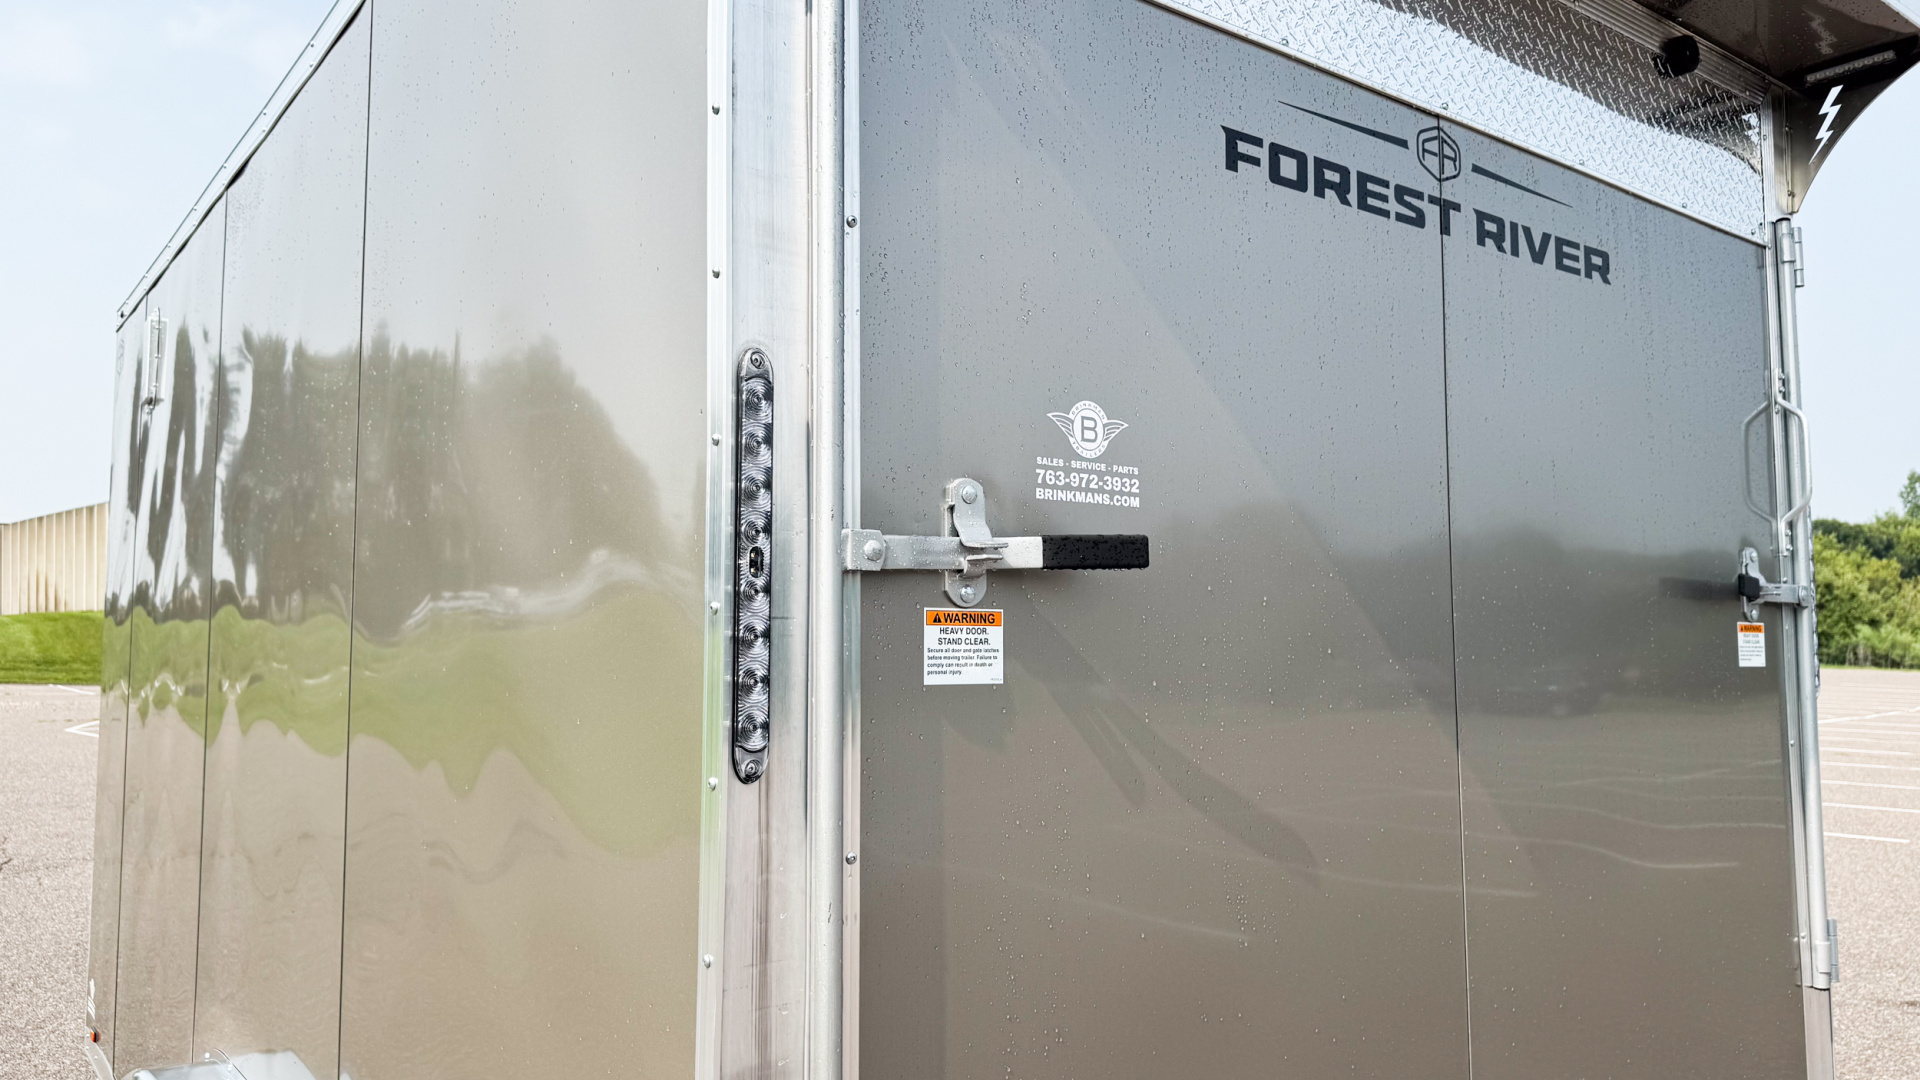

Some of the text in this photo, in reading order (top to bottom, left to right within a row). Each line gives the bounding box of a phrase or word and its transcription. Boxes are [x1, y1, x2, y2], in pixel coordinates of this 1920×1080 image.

[1220, 124, 1611, 285] FOREST RIVER
[1080, 415, 1098, 443] B
[1036, 456, 1064, 467] SALES
[1071, 460, 1106, 471] SERVICE
[1113, 465, 1139, 475] PARTS
[1035, 469, 1140, 493] 763-972-3932
[1035, 487, 1140, 508] BRINKMANS.COM
[943, 612, 995, 624] WARNING
[939, 627, 964, 635] HEAVY
[937, 637, 991, 646] STAND CLEAR.
